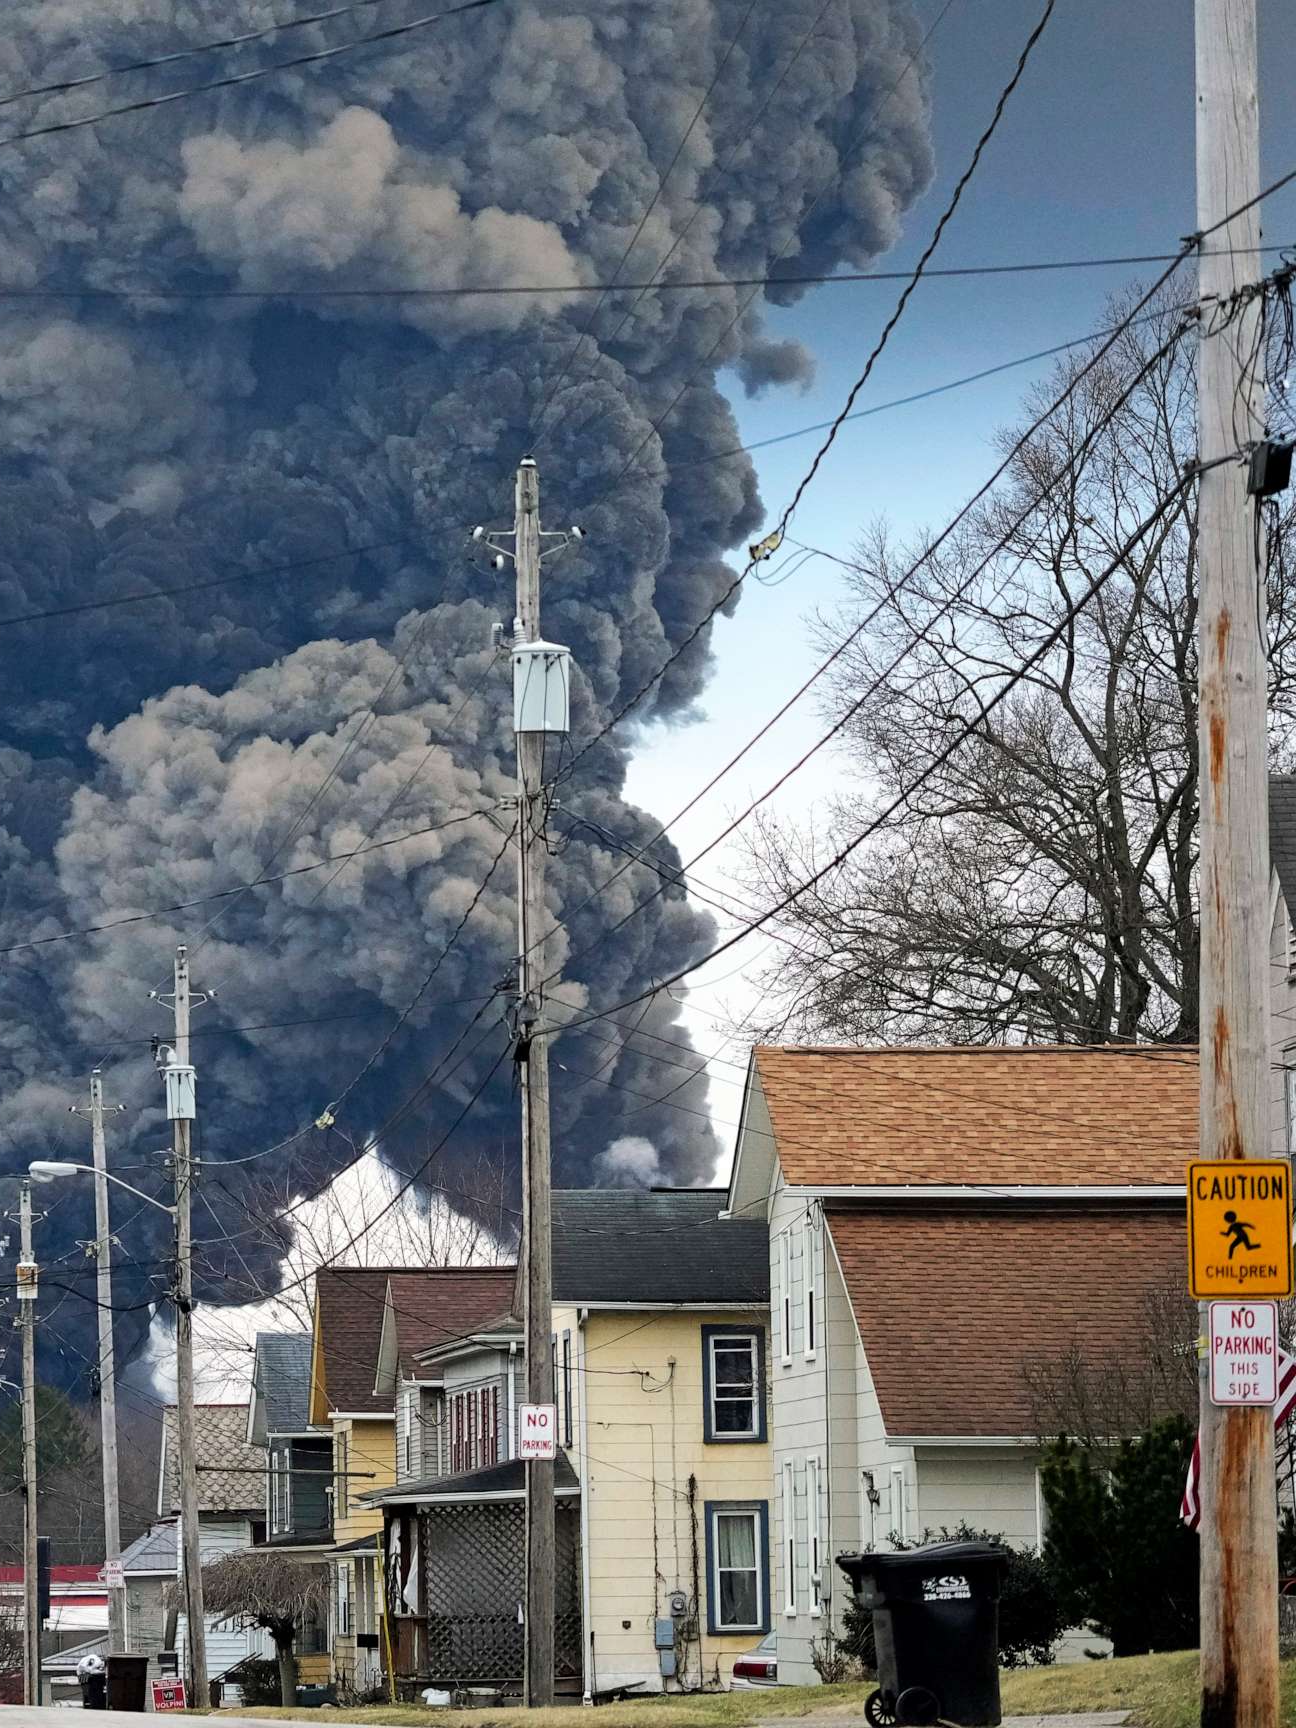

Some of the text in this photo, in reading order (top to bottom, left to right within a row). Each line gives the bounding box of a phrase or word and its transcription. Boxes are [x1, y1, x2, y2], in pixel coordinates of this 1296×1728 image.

[1197, 1174, 1283, 1200] CAUTION
[1205, 1265, 1277, 1279] CHILDREN
[1231, 1310, 1255, 1328] NO
[1215, 1336, 1272, 1355] PARKING
[1230, 1362, 1259, 1375] THIS
[1228, 1383, 1260, 1396] SIDE
[527, 1414, 548, 1427] NO
[522, 1440, 552, 1450] PARKING
[156, 1701, 184, 1709] VOLPINI
